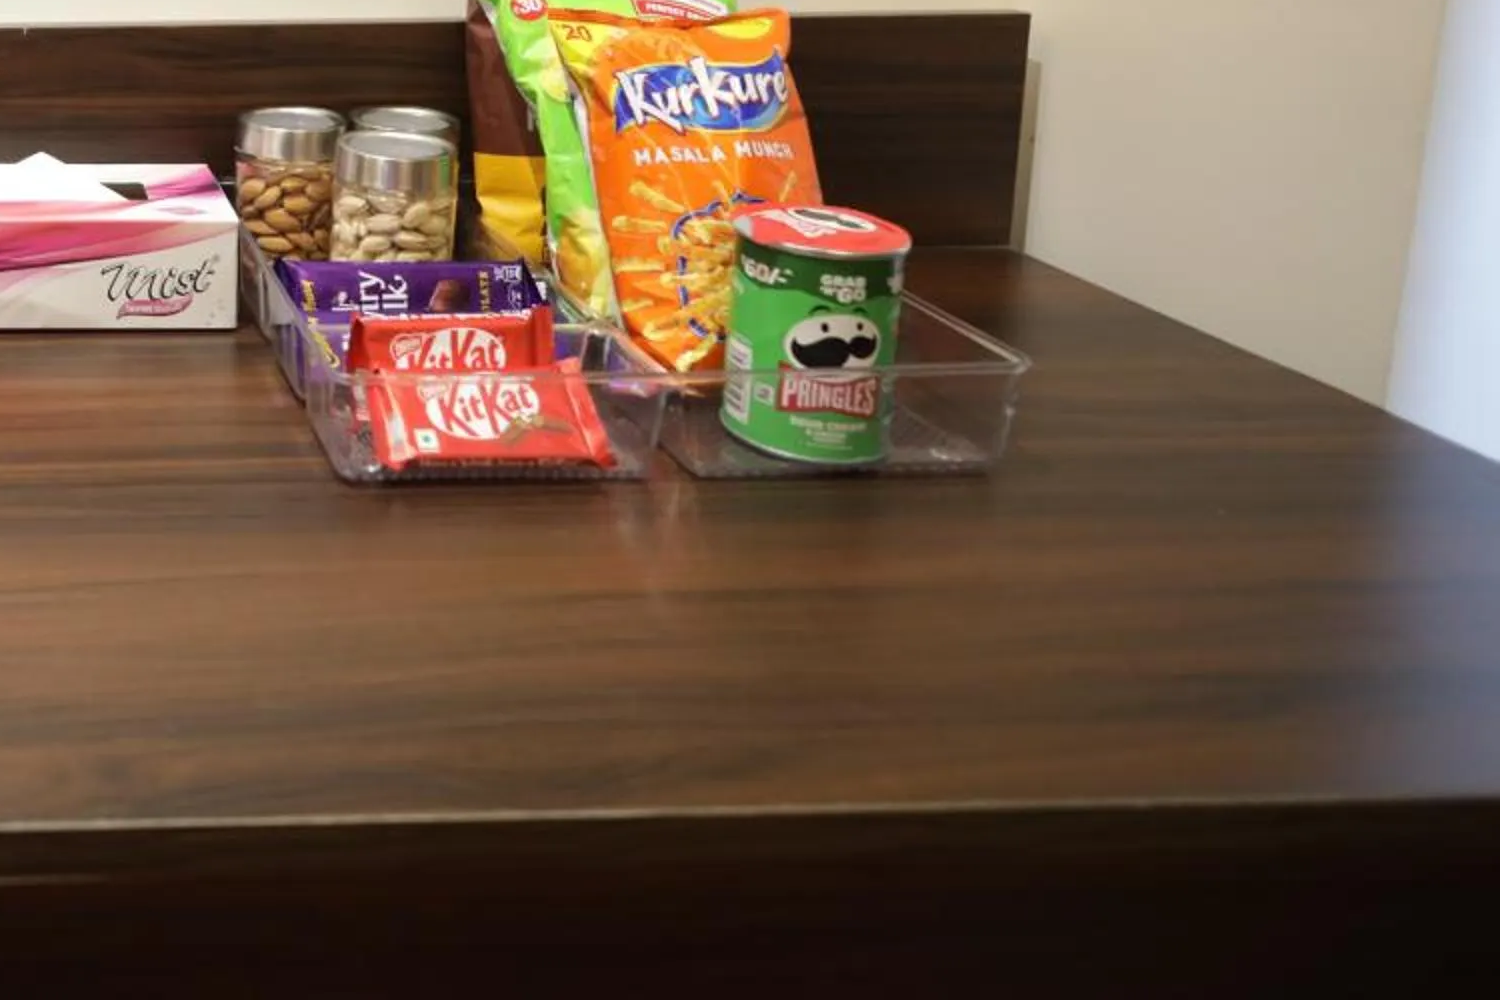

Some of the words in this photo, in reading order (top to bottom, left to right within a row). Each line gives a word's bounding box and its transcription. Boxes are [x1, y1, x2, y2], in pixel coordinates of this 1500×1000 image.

[633, 145, 726, 166] MASALA
[732, 139, 795, 160] MUNCH
[820, 273, 868, 287] GRAB
[781, 372, 877, 417] PRINGLES
[436, 375, 535, 437] KitKat
